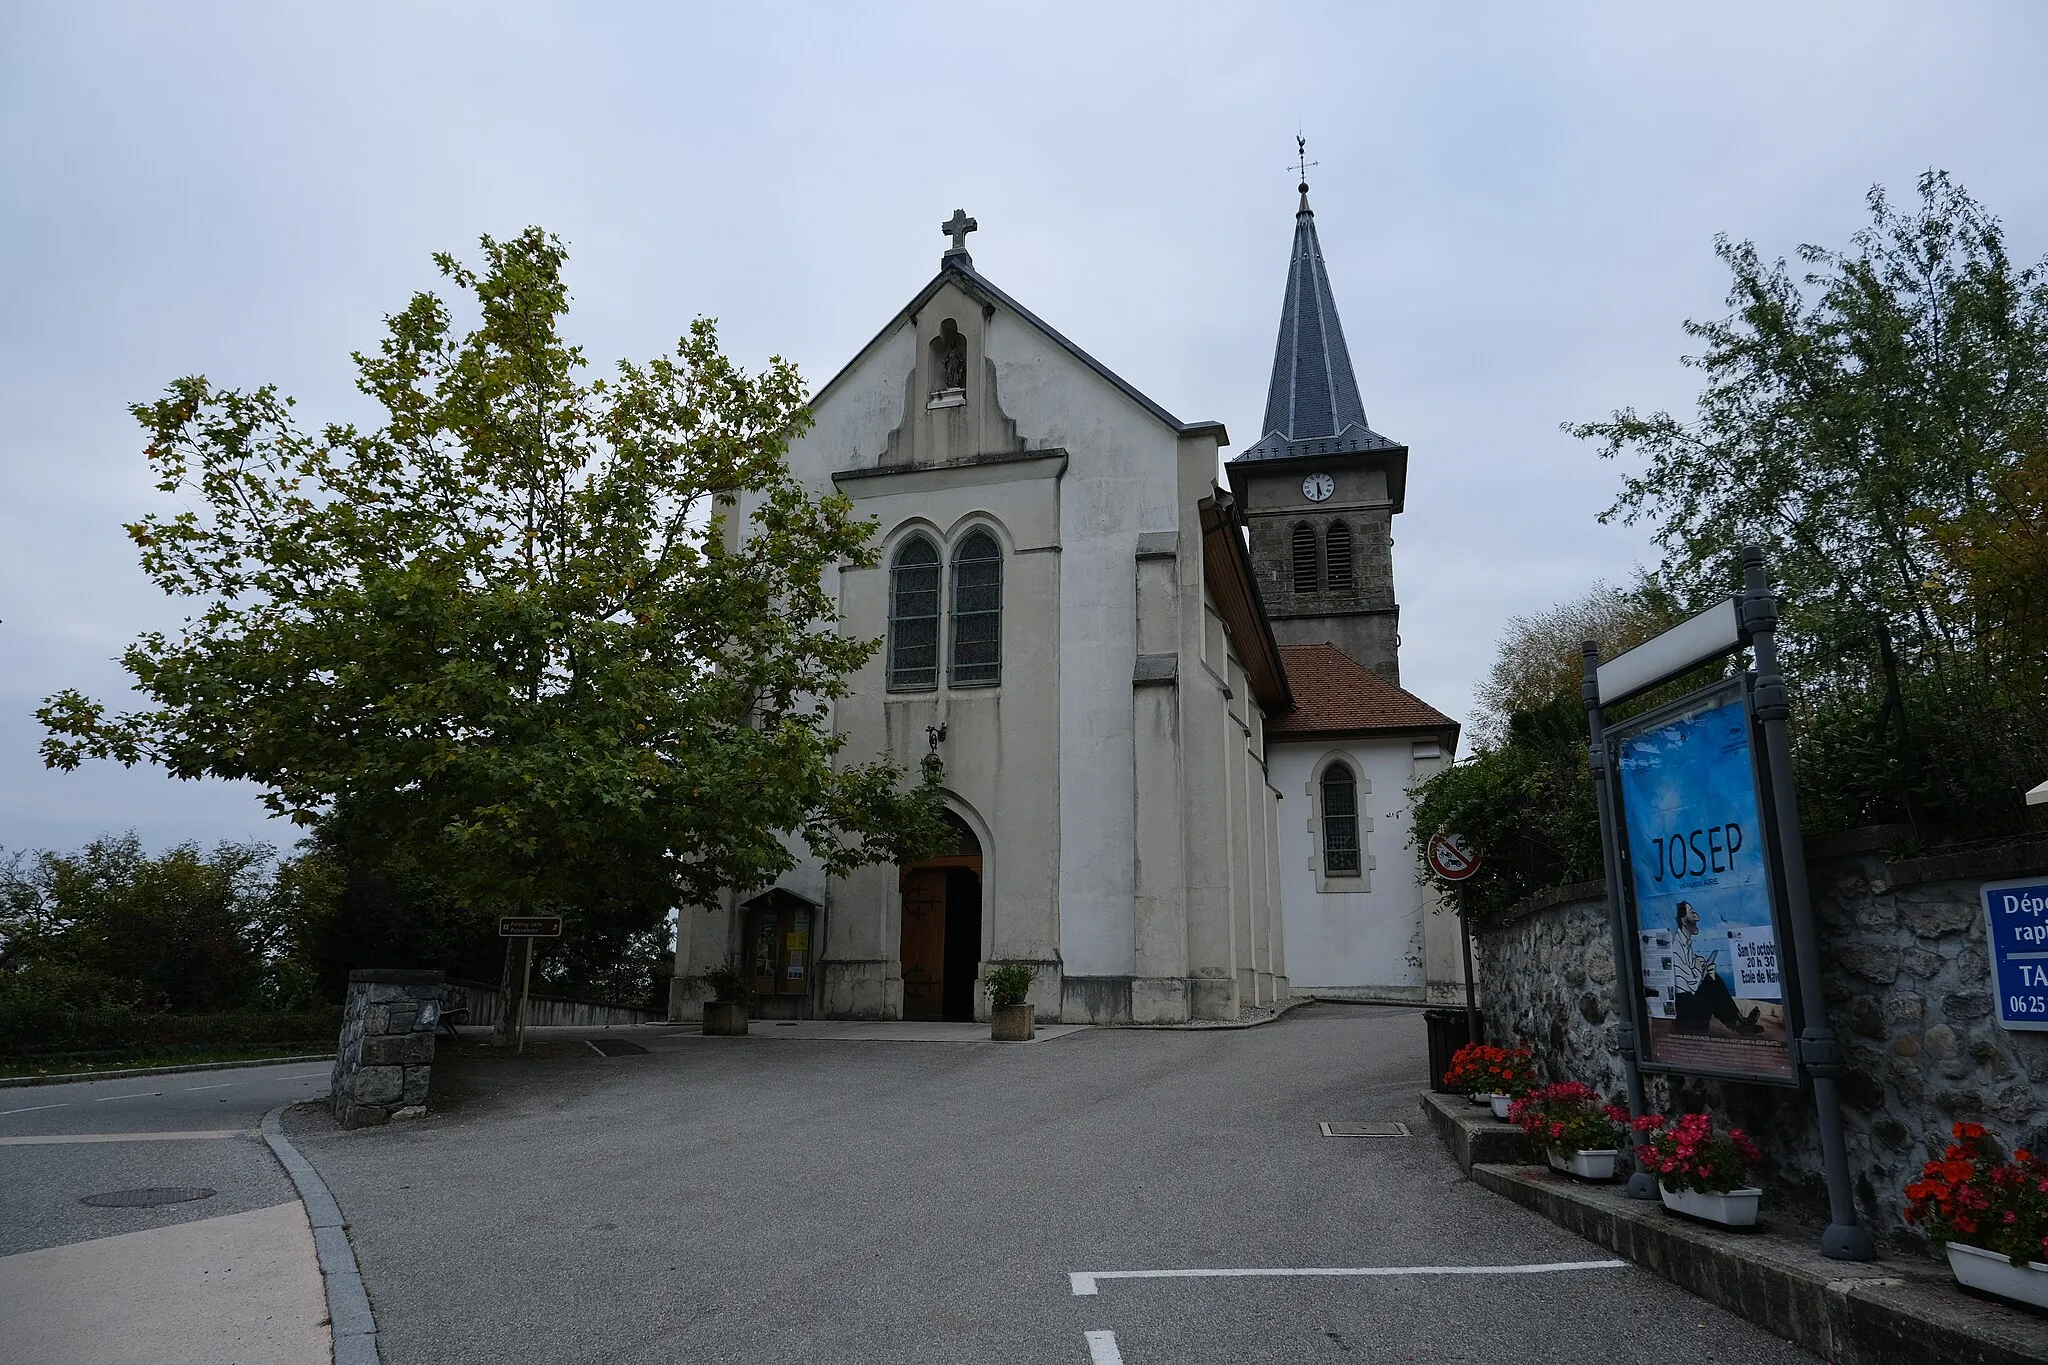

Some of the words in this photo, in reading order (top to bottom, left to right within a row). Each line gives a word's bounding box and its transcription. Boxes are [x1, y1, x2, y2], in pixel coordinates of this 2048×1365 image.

[1652, 822, 1743, 883] JOSEP
[1738, 943, 1749, 957] Sam
[1749, 942, 1756, 956] 16
[1747, 956, 1755, 967] 20
[1756, 957, 1762, 967] h
[1764, 955, 1775, 967] 30
[1741, 969, 1755, 984] Ecole
[1757, 969, 1765, 983] de
[2010, 995, 2027, 1013] 06
[2028, 995, 2046, 1013] 25
